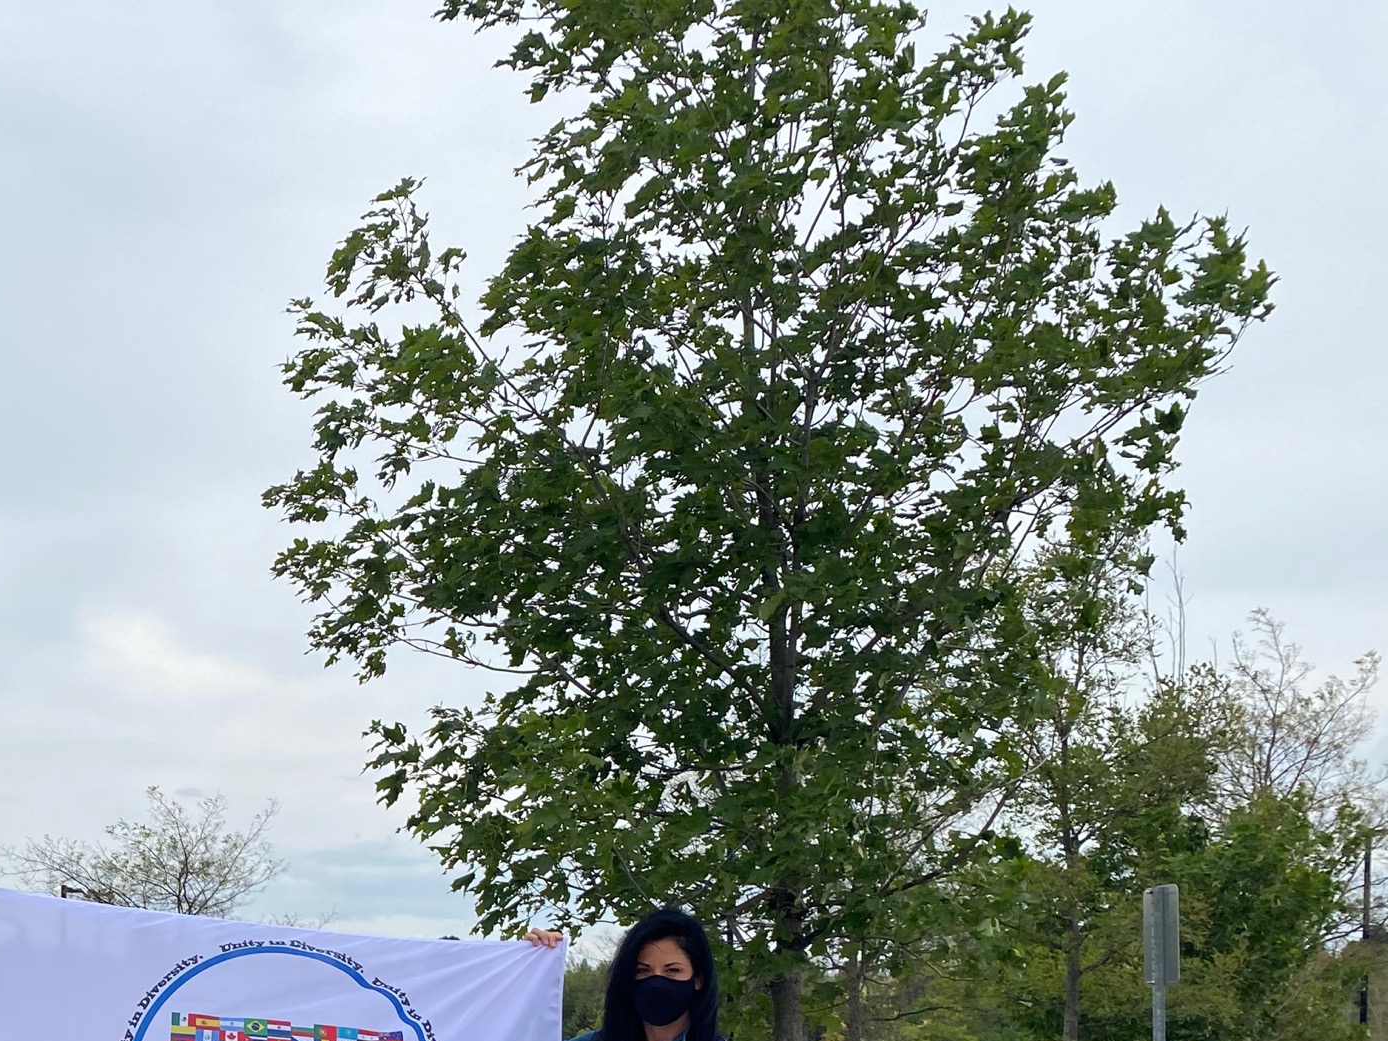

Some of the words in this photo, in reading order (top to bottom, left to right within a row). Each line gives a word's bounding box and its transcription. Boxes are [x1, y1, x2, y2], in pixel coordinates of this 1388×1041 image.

[219, 939, 265, 953] Unity
[289, 940, 364, 974] Diversity.
[128, 1011, 143, 1028] in
[137, 954, 203, 1010] Diversity.
[372, 977, 410, 1007] Unity
[407, 1008, 422, 1021] in
